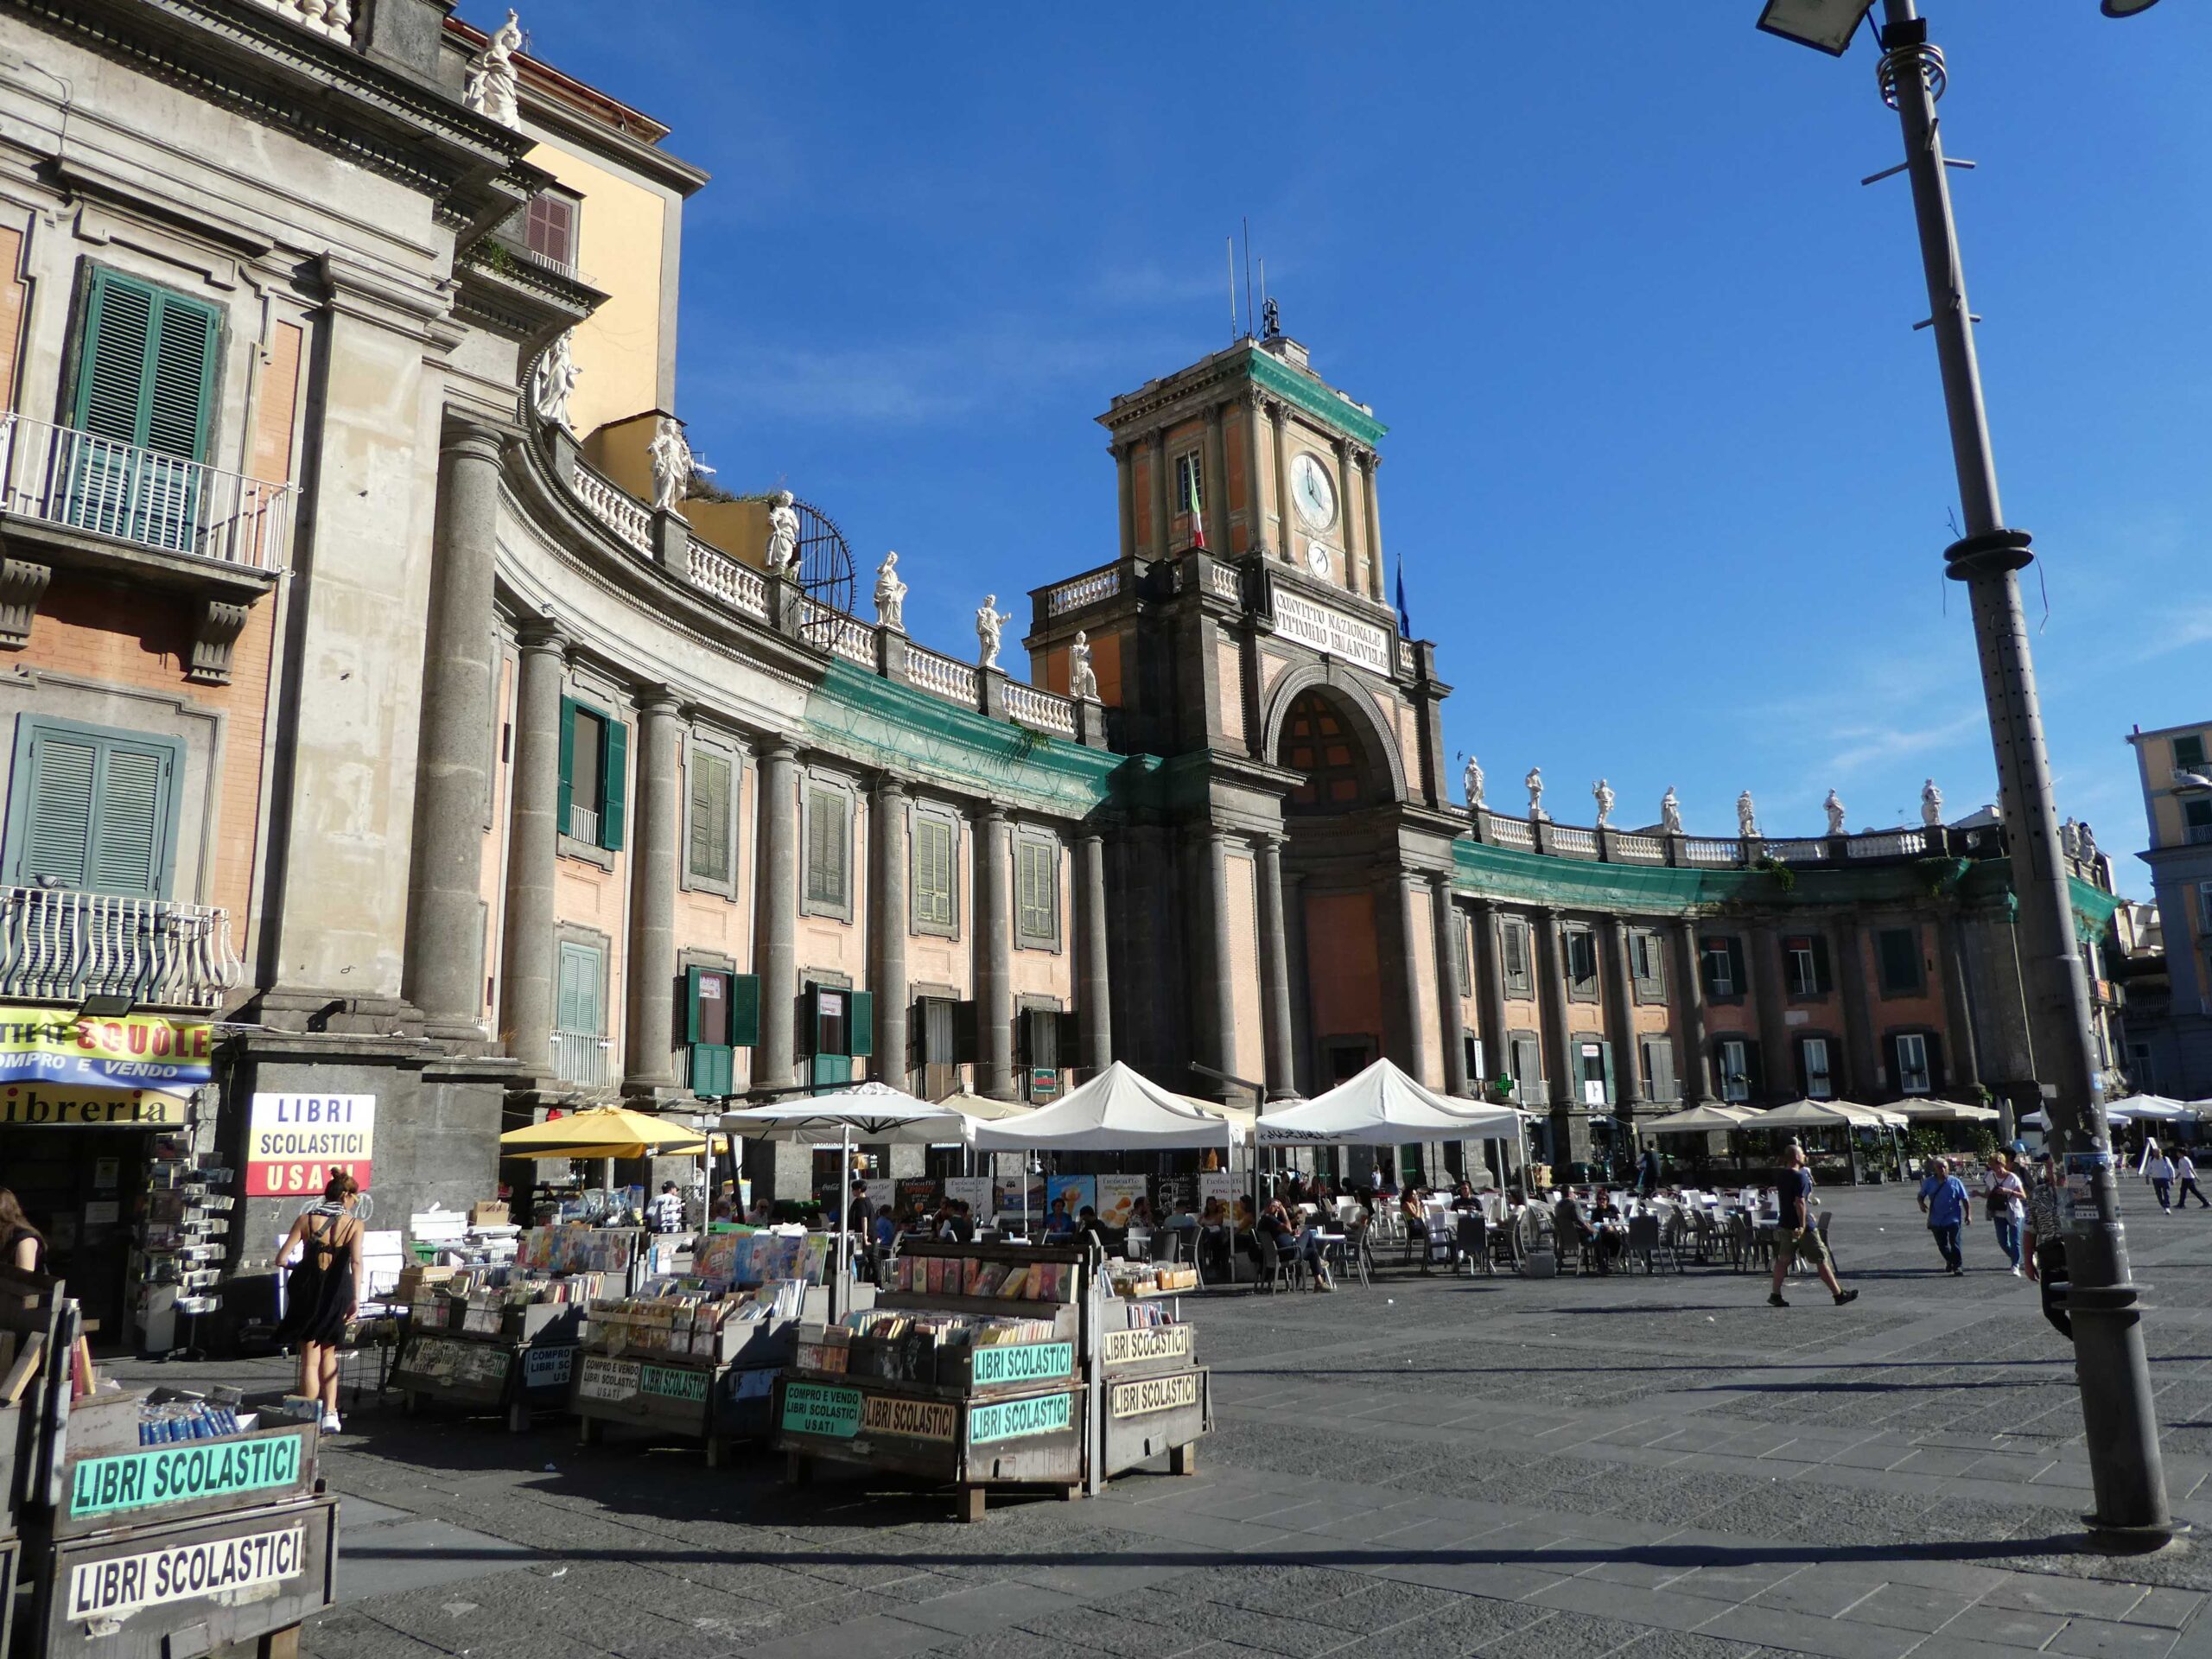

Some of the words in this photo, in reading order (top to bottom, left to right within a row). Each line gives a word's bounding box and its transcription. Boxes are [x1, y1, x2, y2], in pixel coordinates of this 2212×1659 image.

[1274, 610, 1327, 645] VITTORIO
[1276, 594, 1325, 625] CONVITTO
[1328, 613, 1381, 647] NAZIONALE
[77, 1058, 92, 1071] E
[105, 1060, 177, 1078] VENDO
[277, 1098, 352, 1122] LIBRI
[260, 1134, 363, 1154] SCOLASTICI
[532, 1349, 570, 1360] COMPRO
[1103, 1334, 1128, 1361] LIBRI
[531, 1362, 555, 1372] LIBRI
[586, 1359, 611, 1371] COMPRO
[613, 1363, 617, 1372] E
[618, 1363, 639, 1376] VENDO
[975, 1351, 1004, 1380] LIBRI
[1007, 1345, 1070, 1377] SCOLASTICI
[583, 1372, 599, 1382] LIBRI
[601, 1374, 638, 1389] SCOLASTICI
[642, 1367, 662, 1392] LIBRI
[663, 1370, 709, 1401] SCOLASTICI
[596, 1388, 620, 1398] USATI
[788, 1387, 821, 1401] COMPRO
[823, 1390, 829, 1401] E
[831, 1391, 859, 1405] VENDO
[1115, 1384, 1139, 1414] LIBRI
[1141, 1374, 1196, 1409] SCOLASTICI
[786, 1402, 807, 1414] LIBRI
[810, 1403, 857, 1421] SCOLASTICI
[866, 1399, 892, 1428] LIBRI
[893, 1402, 953, 1436] SCOLASTICI
[973, 1408, 1002, 1440] LIBRI
[1005, 1397, 1068, 1433] SCOLASTICI
[804, 1419, 835, 1433] USATI
[76, 1458, 146, 1508] LIBRI
[154, 1440, 297, 1497] SCOLASTICI
[76, 1557, 148, 1613] LIBRI
[155, 1531, 301, 1598] SCOLASTICI
